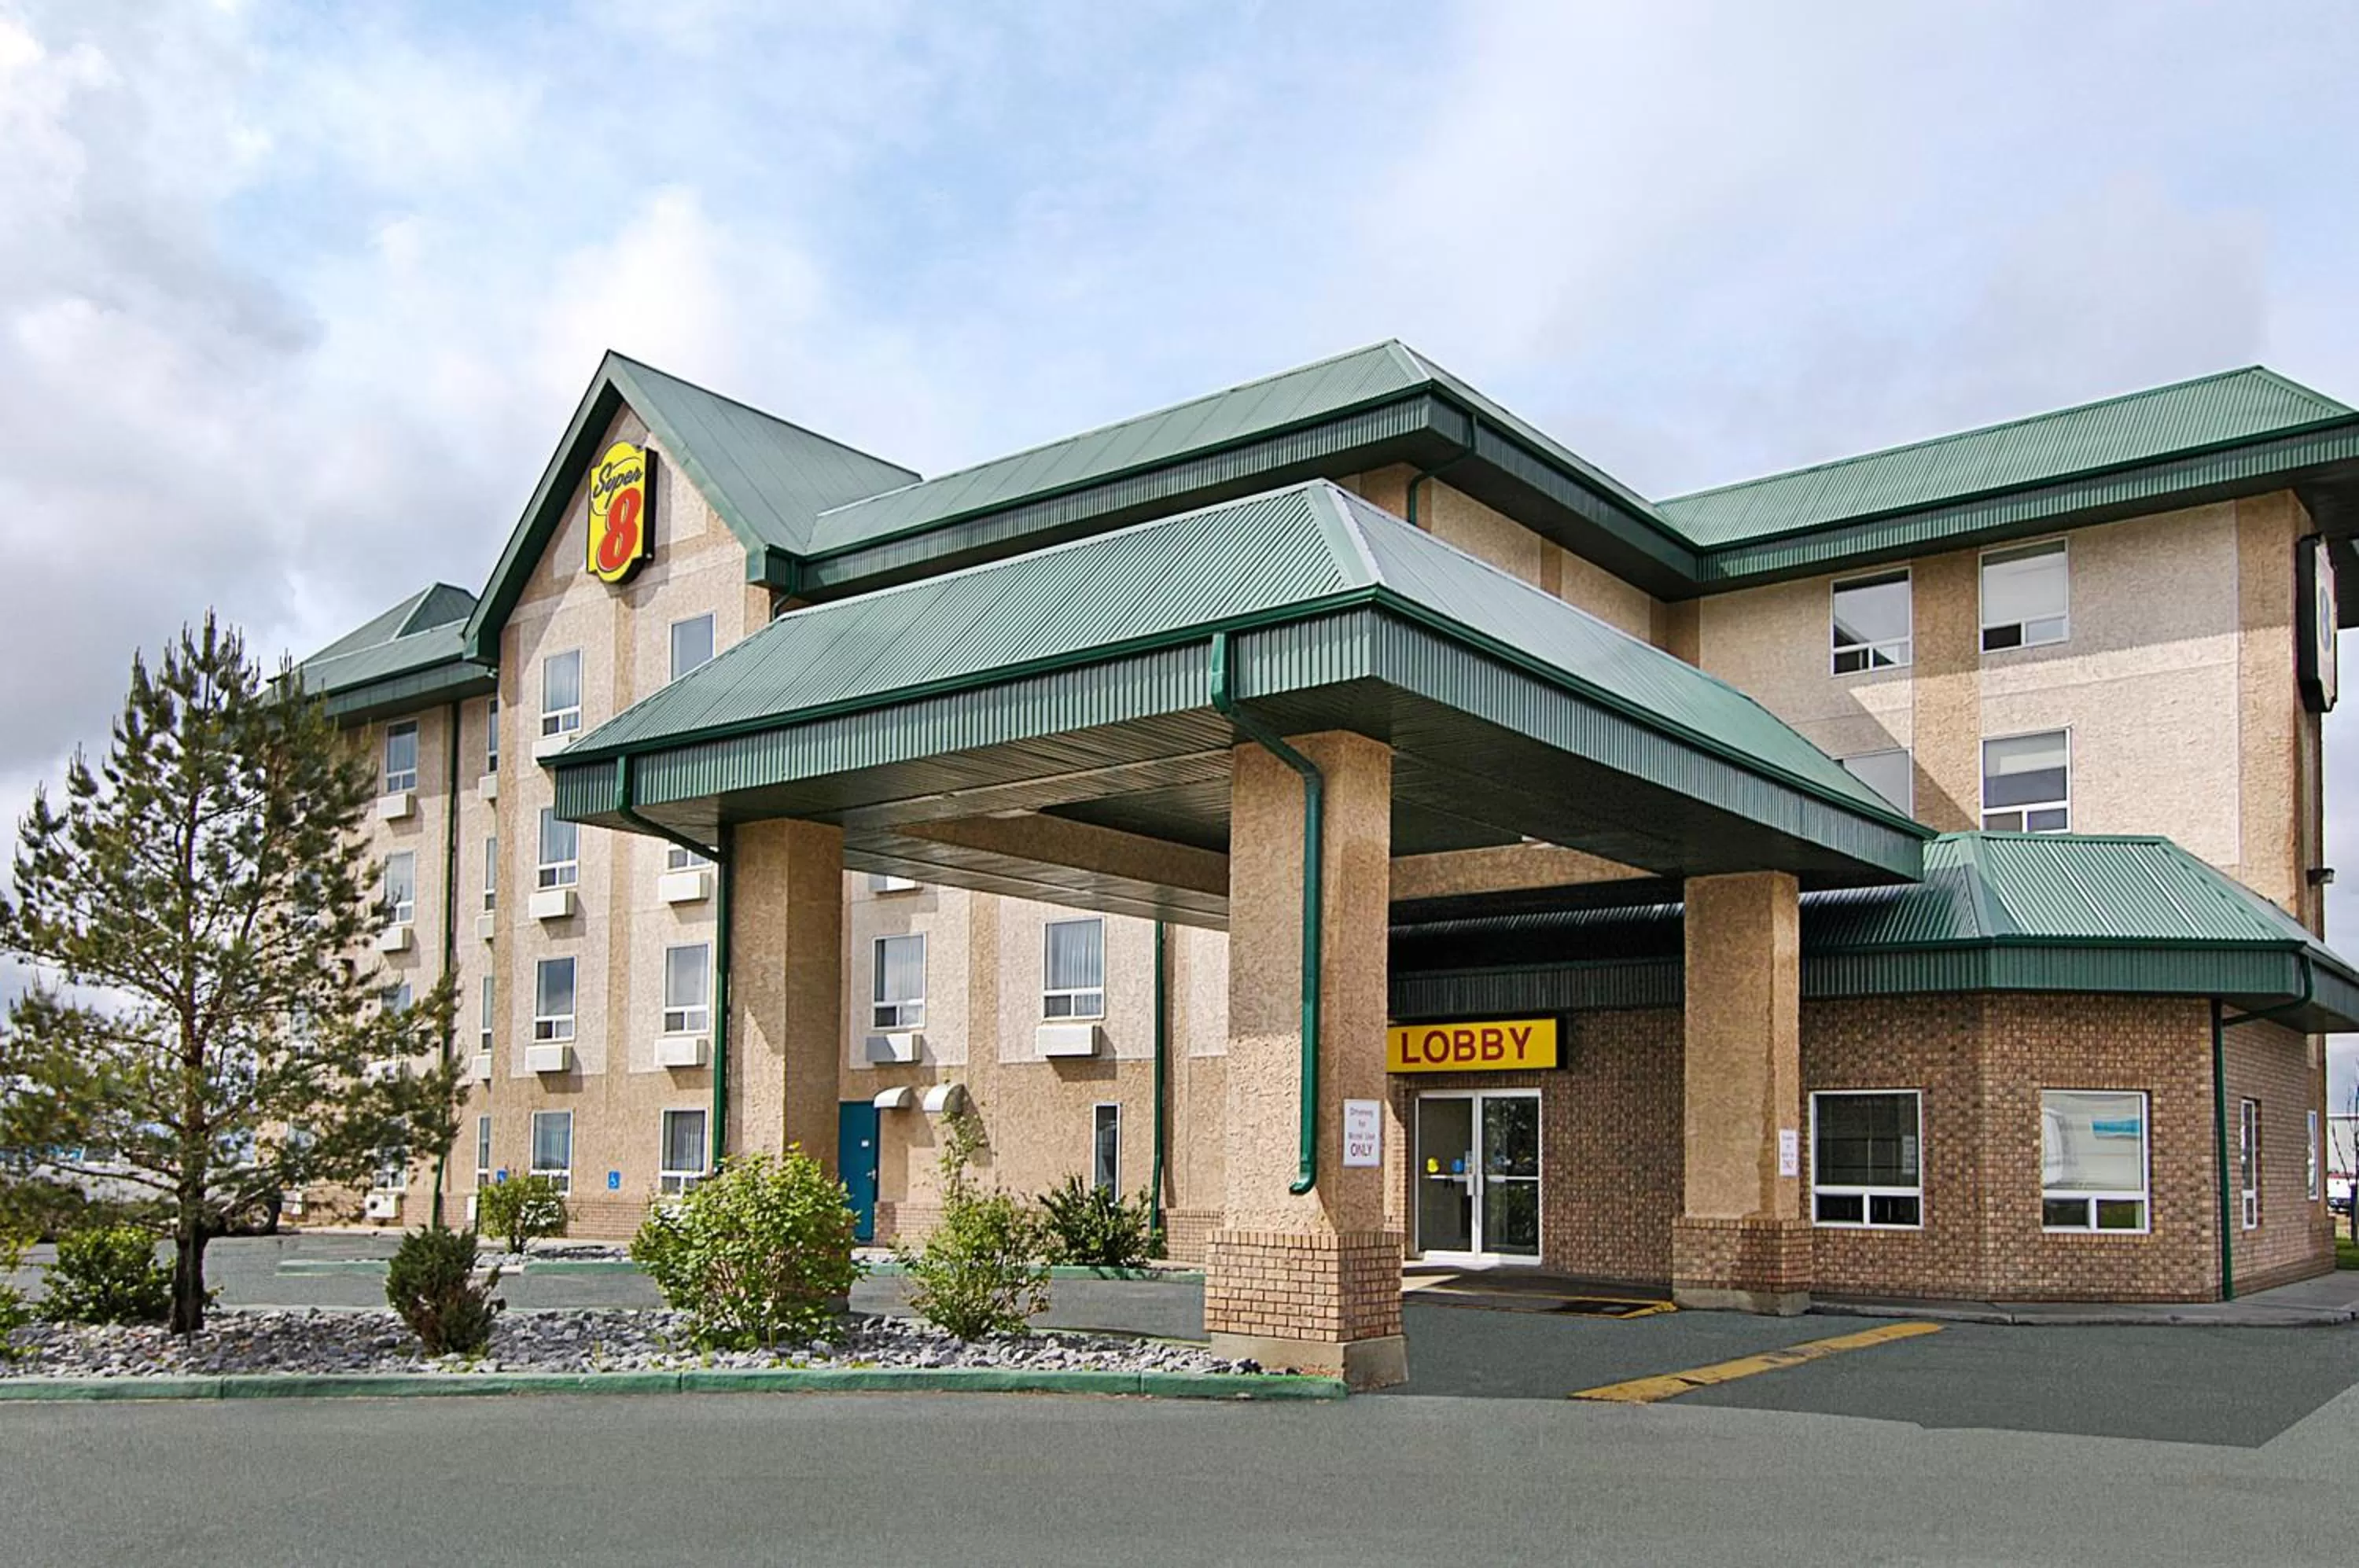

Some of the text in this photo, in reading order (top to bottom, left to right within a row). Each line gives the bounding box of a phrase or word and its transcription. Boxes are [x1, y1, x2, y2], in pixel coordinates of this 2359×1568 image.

[593, 462, 642, 510] Super
[598, 487, 642, 571] 8
[1400, 1026, 1533, 1064] LOBBY
[1350, 1143, 1372, 1157] ONLY
